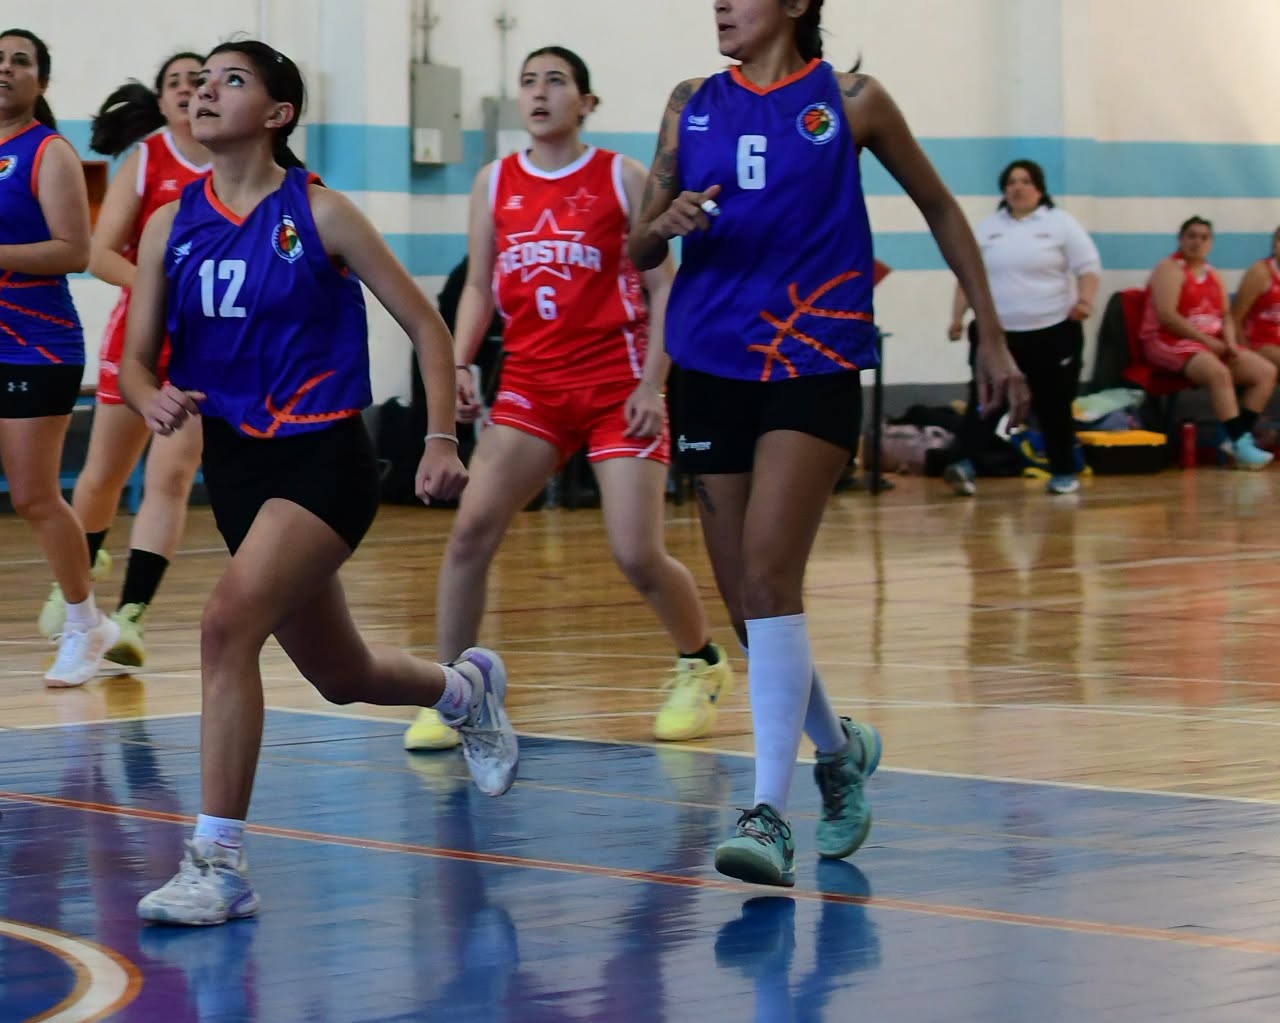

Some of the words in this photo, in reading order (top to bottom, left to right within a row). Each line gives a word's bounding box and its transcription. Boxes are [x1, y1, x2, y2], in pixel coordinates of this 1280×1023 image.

[736, 134, 768, 190] 6
[198, 259, 247, 318] 12
[535, 285, 558, 321] 6
